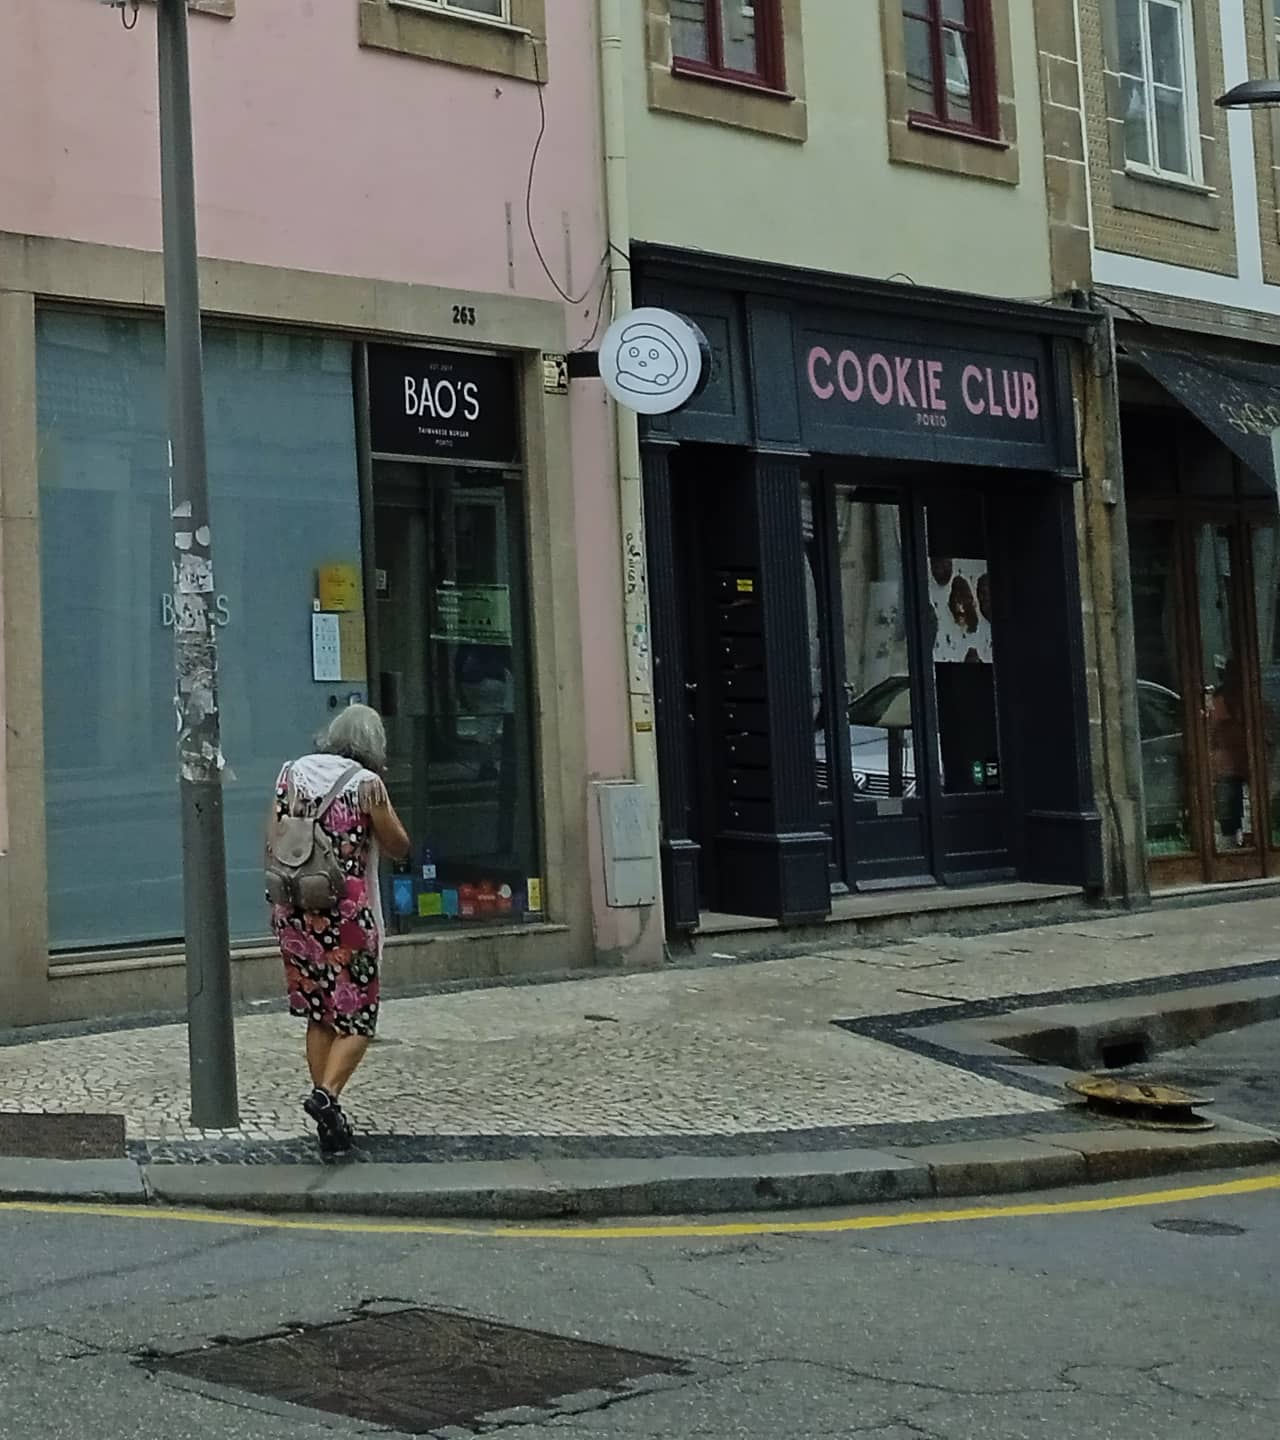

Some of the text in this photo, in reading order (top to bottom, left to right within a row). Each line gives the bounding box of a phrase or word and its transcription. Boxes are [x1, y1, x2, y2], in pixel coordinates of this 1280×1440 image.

[452, 305, 476, 326] 263
[404, 375, 480, 421] BAO'S
[807, 346, 1039, 421] COOKIE CLUB
[916, 412, 948, 428] PORTO
